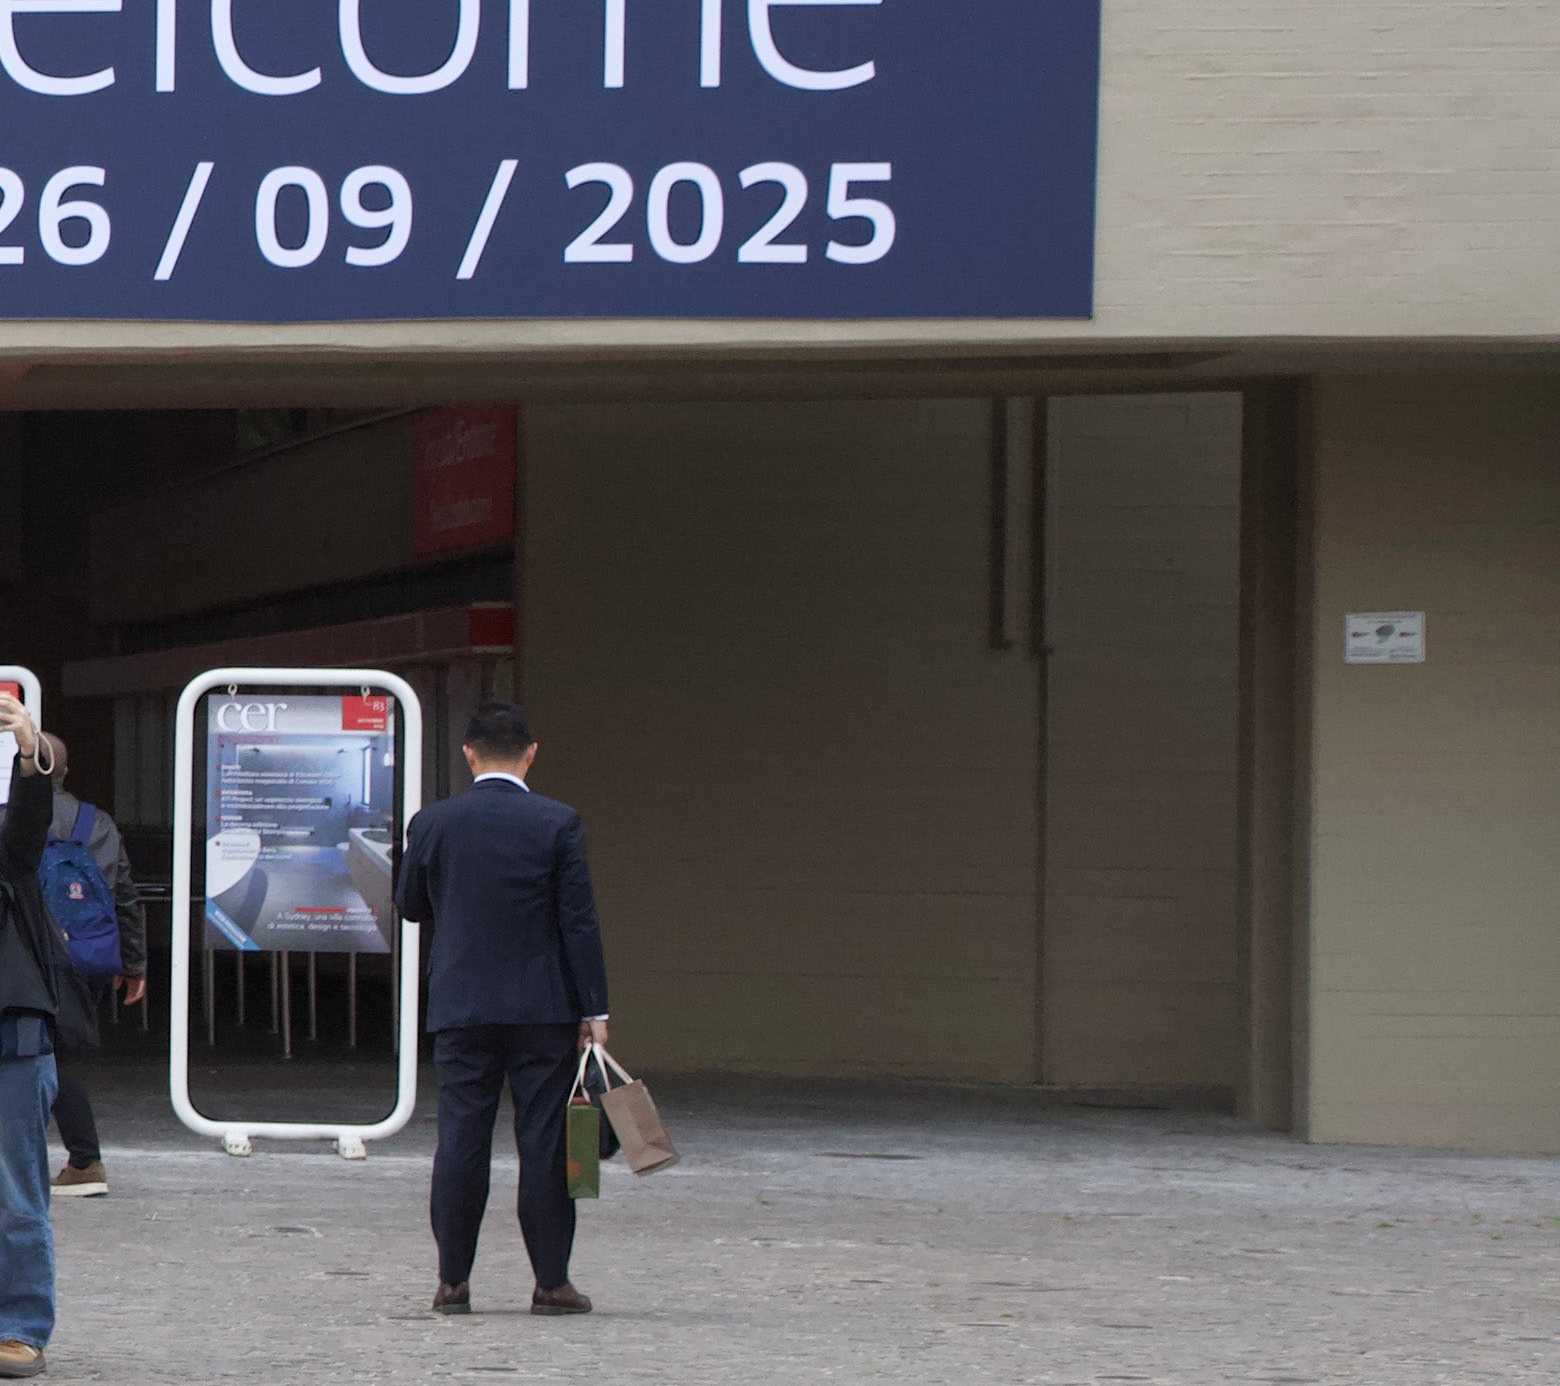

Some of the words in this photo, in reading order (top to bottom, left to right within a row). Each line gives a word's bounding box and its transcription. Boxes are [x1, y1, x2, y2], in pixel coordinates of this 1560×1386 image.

[154, 162, 214, 280] /
[256, 166, 412, 267] 09
[457, 160, 518, 279] /
[565, 162, 895, 263] 2025
[217, 702, 288, 732] cer
